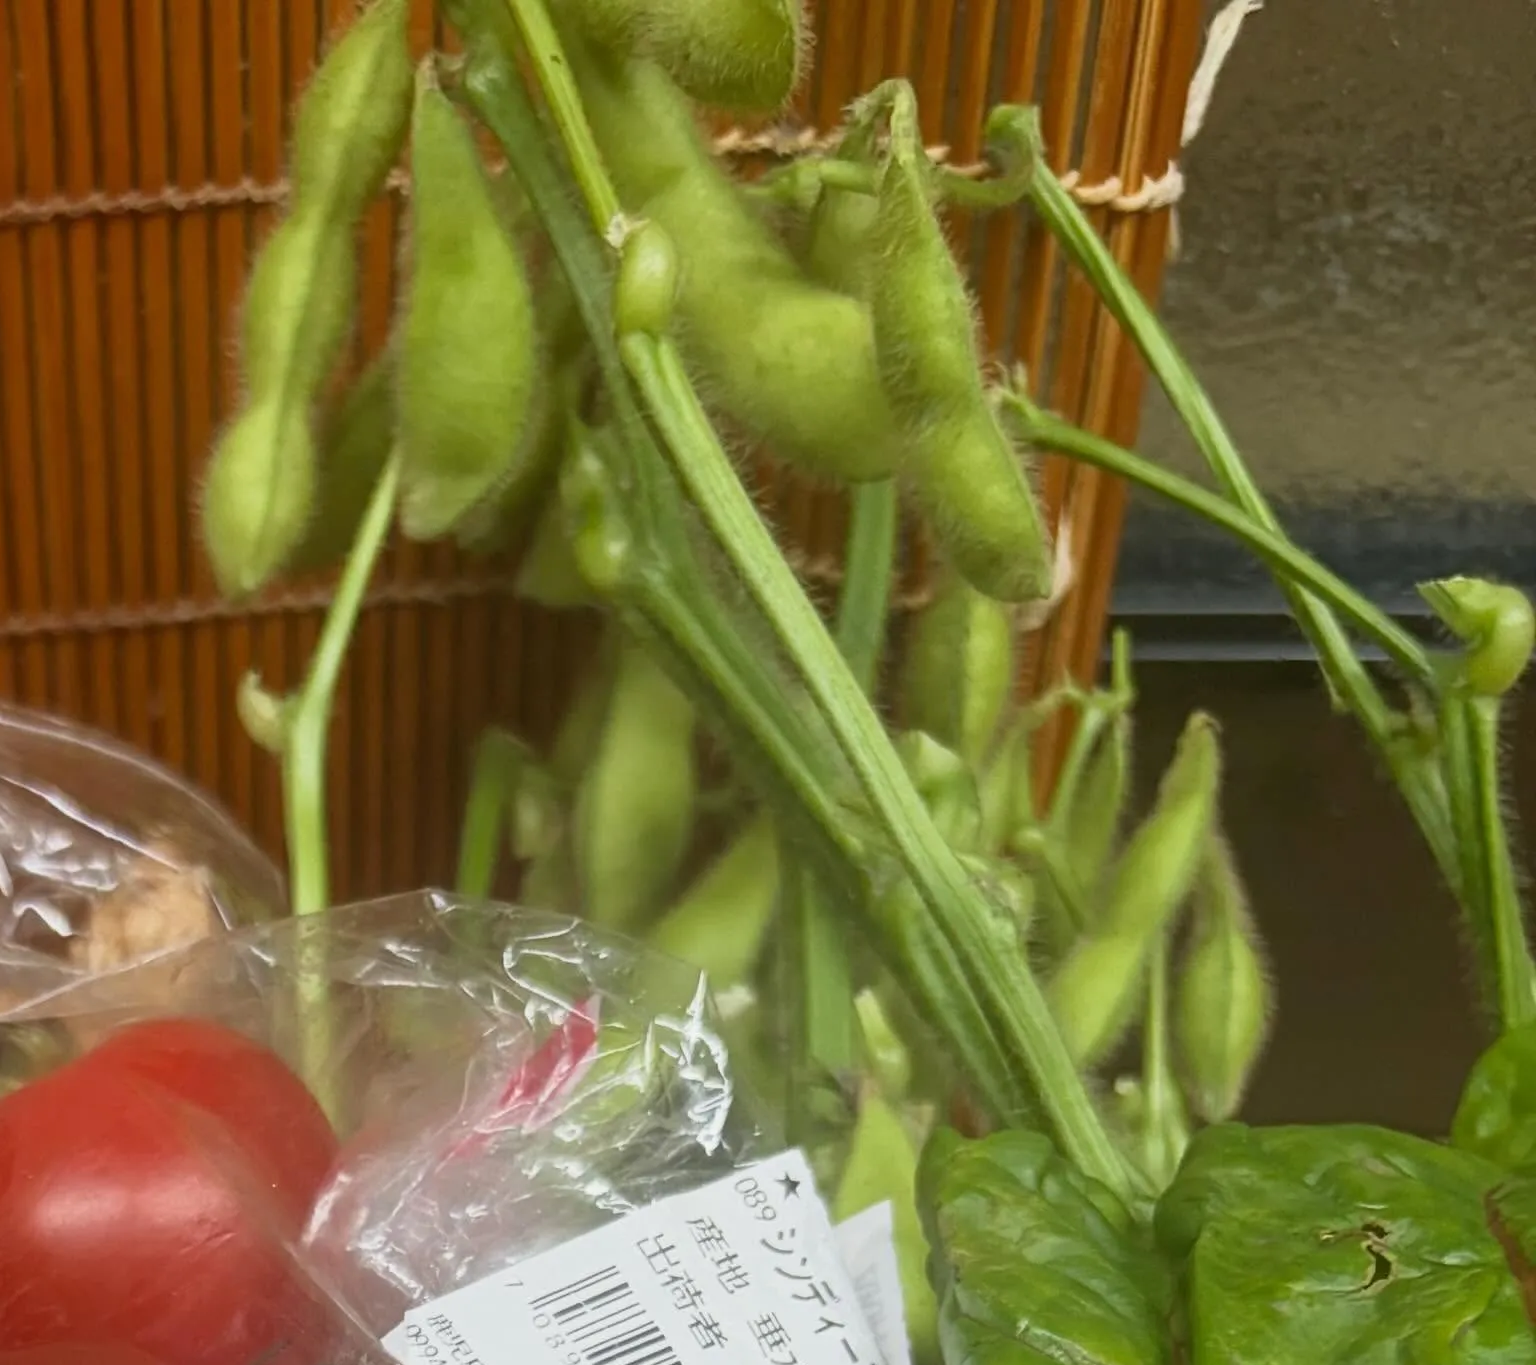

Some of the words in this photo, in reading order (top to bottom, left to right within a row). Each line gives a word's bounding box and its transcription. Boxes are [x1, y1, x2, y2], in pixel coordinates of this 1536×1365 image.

[734, 1177, 778, 1226] 089
[636, 1232, 729, 1352] 出荷者
[685, 1215, 752, 1295] 産地
